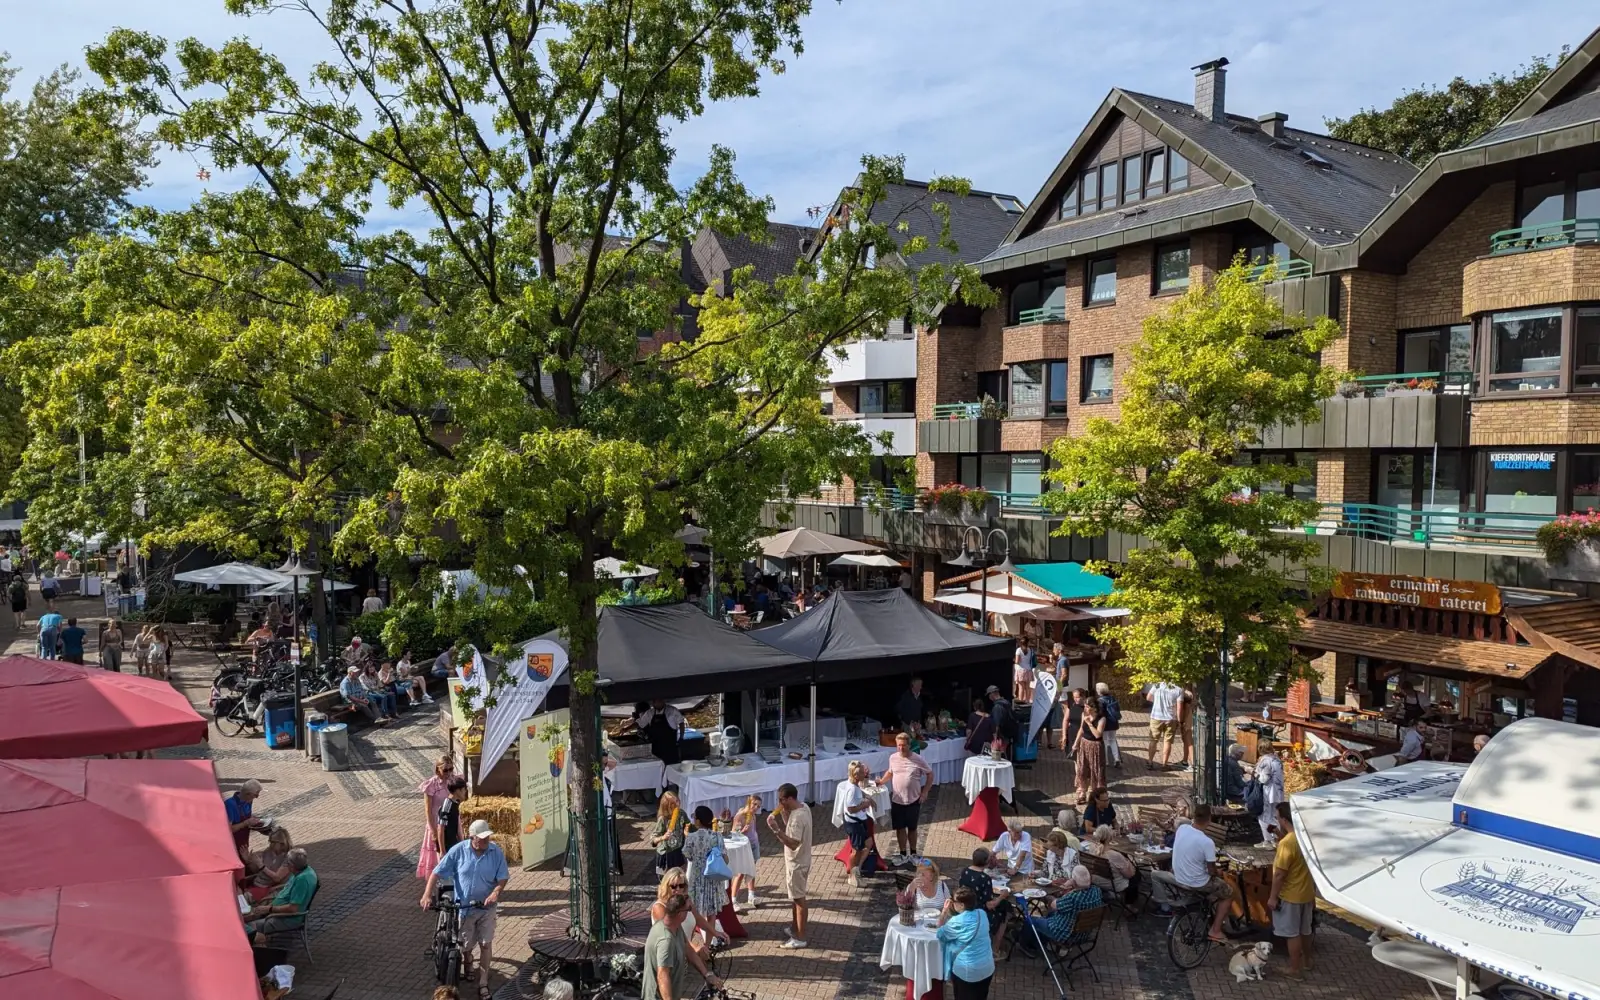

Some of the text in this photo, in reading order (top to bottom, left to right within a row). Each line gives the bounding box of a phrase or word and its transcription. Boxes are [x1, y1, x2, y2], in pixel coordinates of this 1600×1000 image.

[1490, 452, 1556, 462] KIEFERORTHOPÄDIE
[1494, 461, 1551, 470] KURZZEITSPANGE
[527, 771, 548, 782] Tradition
[1470, 878, 1578, 915] Schumacher
[1489, 895, 1526, 910] Alt
